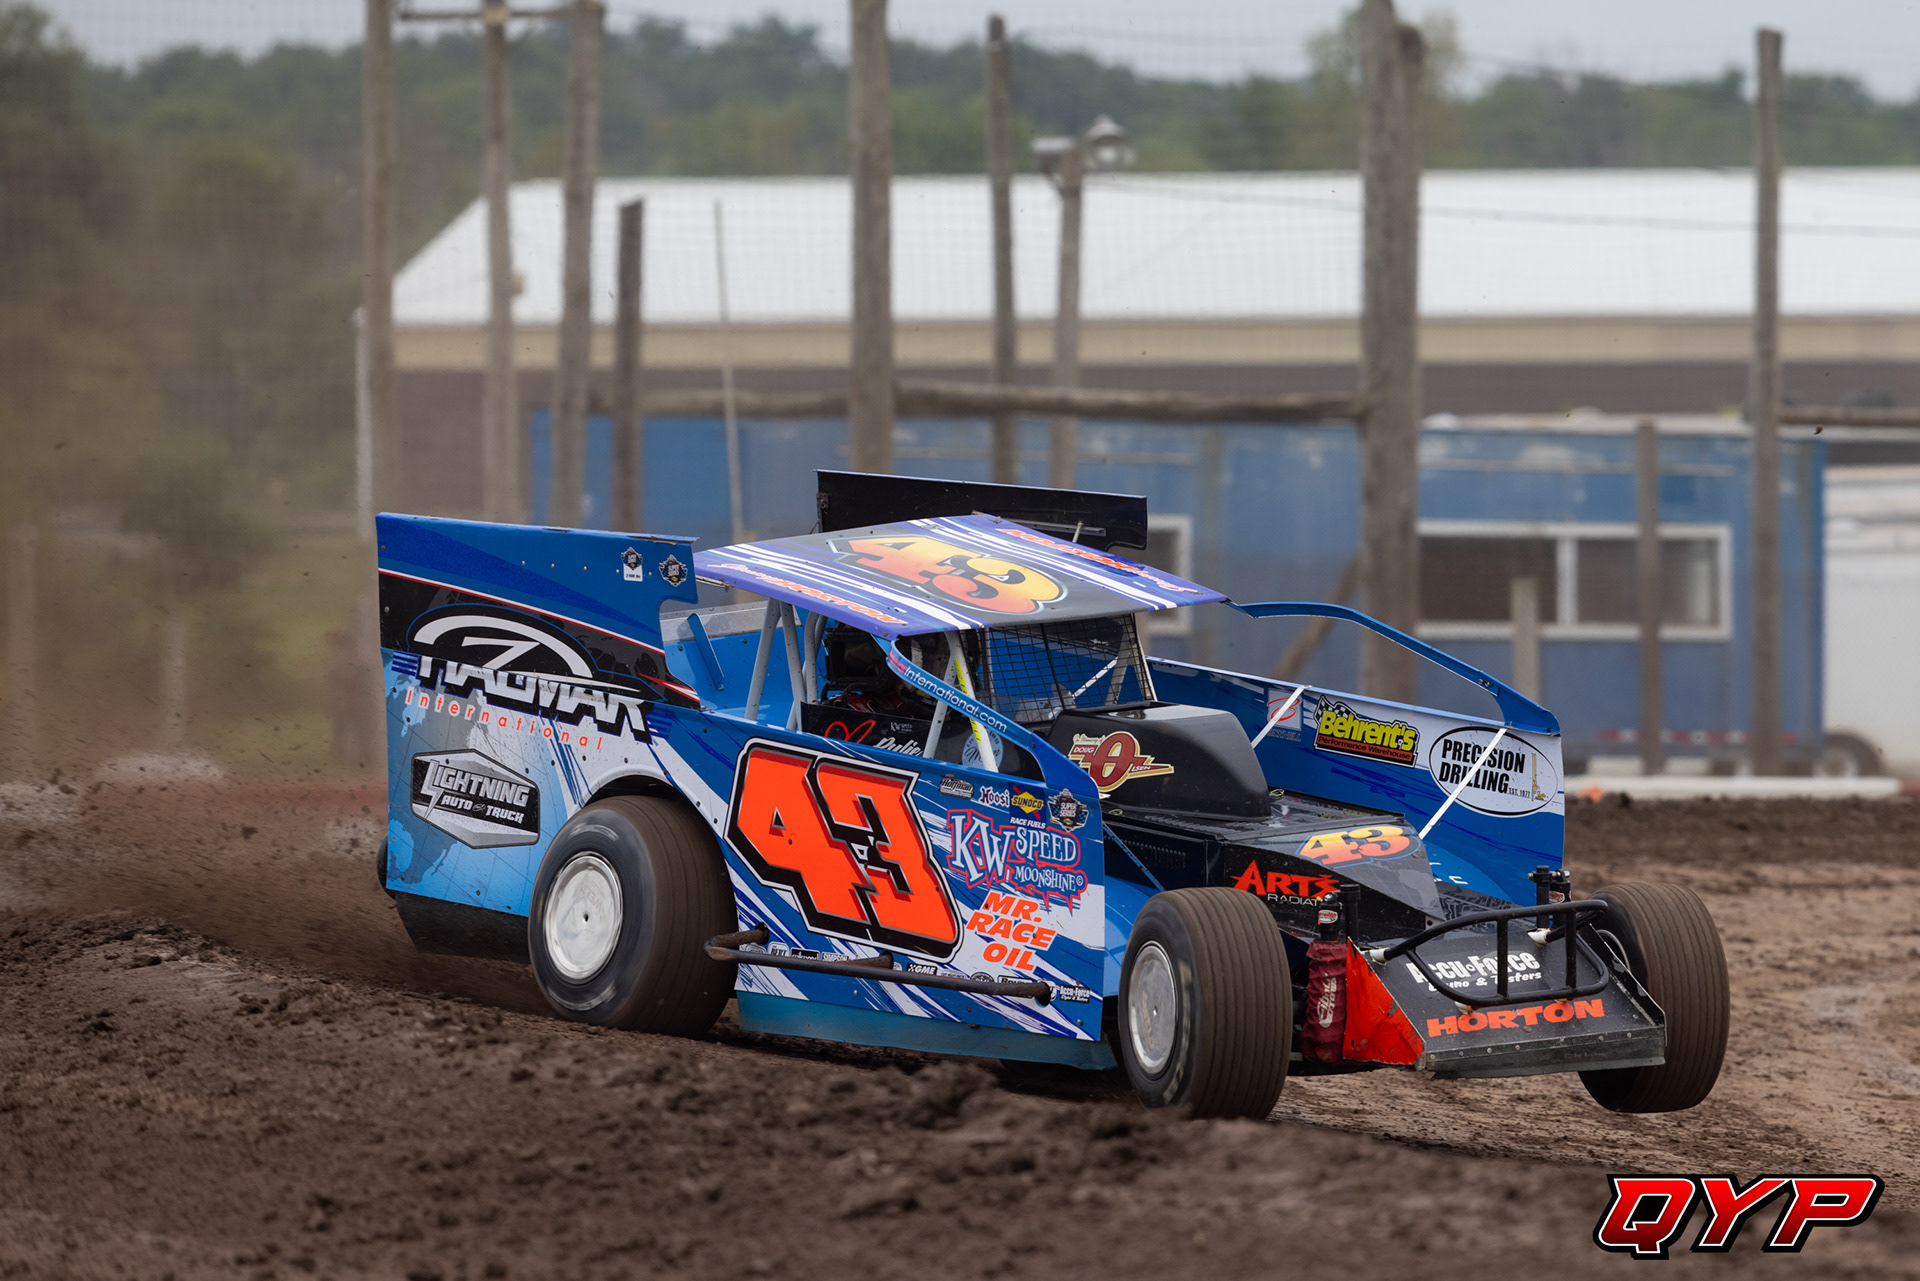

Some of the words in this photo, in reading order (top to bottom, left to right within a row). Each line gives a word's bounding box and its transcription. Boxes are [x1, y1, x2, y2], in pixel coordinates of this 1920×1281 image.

[848, 536, 1060, 614] 43
[406, 689, 603, 750] International
[1319, 710, 1416, 751] Behrent's
[1318, 736, 1367, 751] Performance
[1368, 745, 1411, 760] Warehouse
[420, 759, 530, 819] LIGHTNING
[980, 787, 1009, 807] Hoosi
[1012, 796, 1044, 809] SUNOCO
[441, 795, 473, 810] AUTO
[485, 805, 525, 824] TRUCK
[1010, 817, 1027, 826] RACE
[1027, 819, 1046, 829] FUELS
[735, 749, 959, 943] 43
[951, 815, 1015, 882] KW
[1015, 827, 1077, 862] SPEED
[1299, 826, 1411, 865] 43
[982, 891, 1042, 923] MR.
[966, 911, 1056, 948] RACE
[983, 943, 1034, 971] OIL
[1475, 977, 1488, 986] &
[1426, 998, 1605, 1038] HORTON
